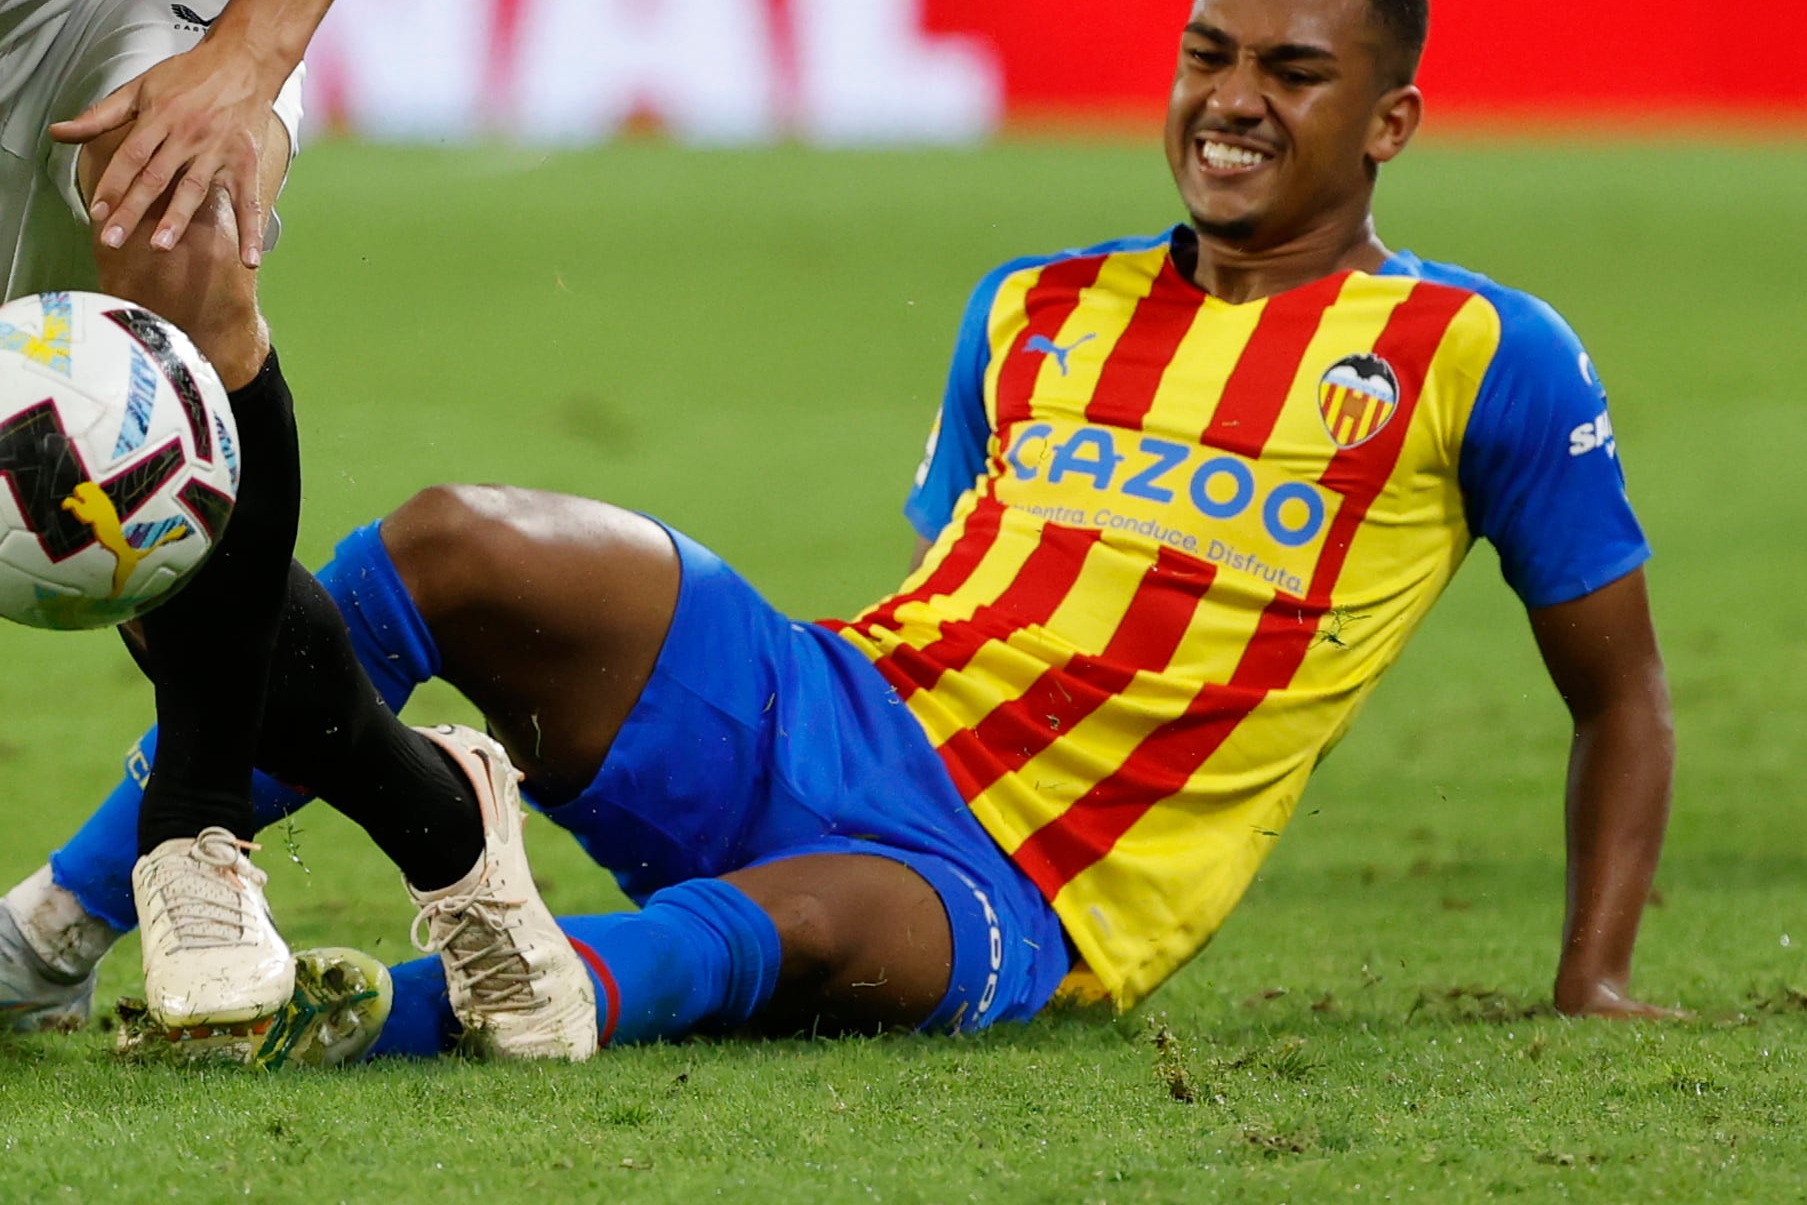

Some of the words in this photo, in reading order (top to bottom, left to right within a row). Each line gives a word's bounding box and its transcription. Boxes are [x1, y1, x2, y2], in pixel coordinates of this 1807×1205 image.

[173, 24, 208, 35] CAST
[1006, 423, 1325, 547] CAZOO
[1093, 508, 1198, 552] Conduce.
[1207, 540, 1303, 595] Disfruta.
